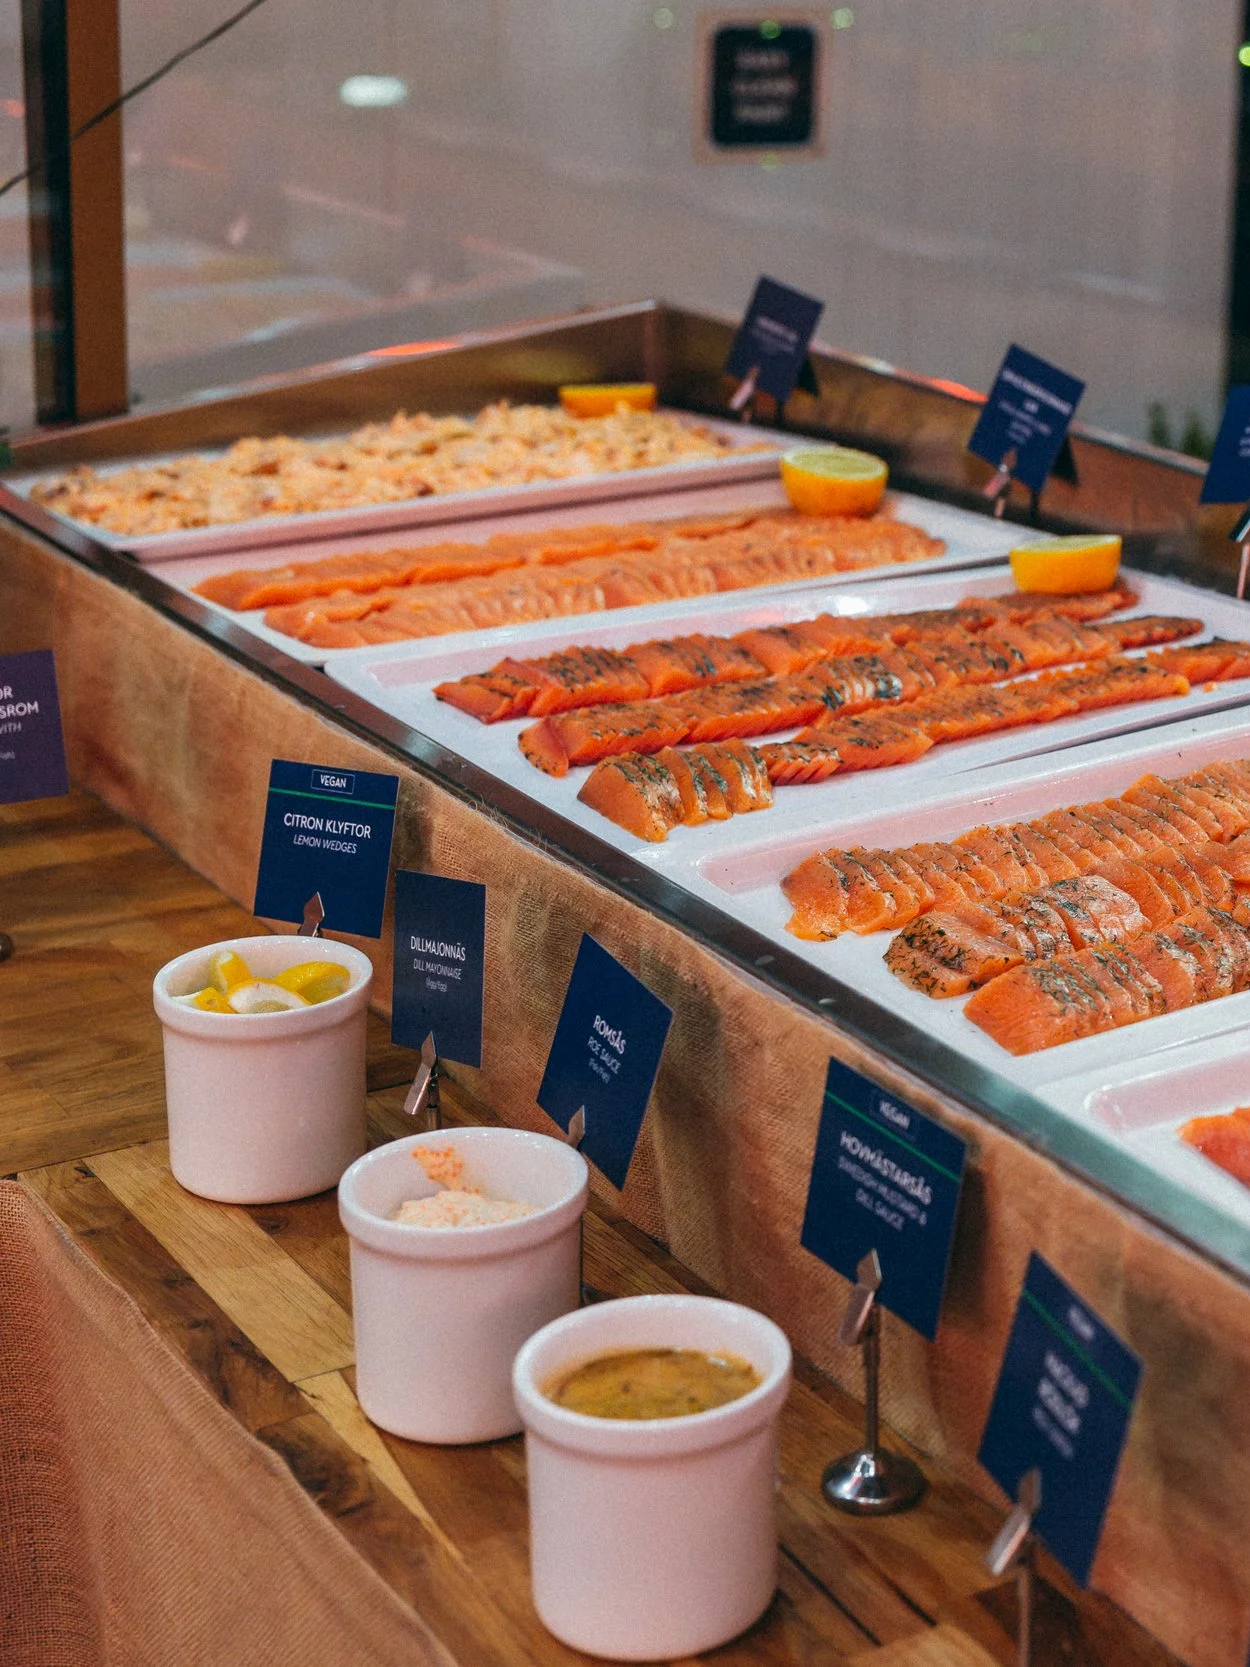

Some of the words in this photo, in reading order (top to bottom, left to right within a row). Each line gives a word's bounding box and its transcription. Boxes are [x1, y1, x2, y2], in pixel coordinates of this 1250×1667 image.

[320, 774, 347, 788] VEGAN
[283, 812, 323, 832] CITRON
[325, 819, 371, 839] KLYFTOR
[293, 834, 321, 849] LEMON
[322, 839, 358, 854] WEDGES
[410, 935, 466, 961] DILLMAJONNÄS
[413, 958, 425, 972] DILL
[425, 961, 462, 980] MAYONNAISE
[593, 1015, 626, 1055] ROMSÅS
